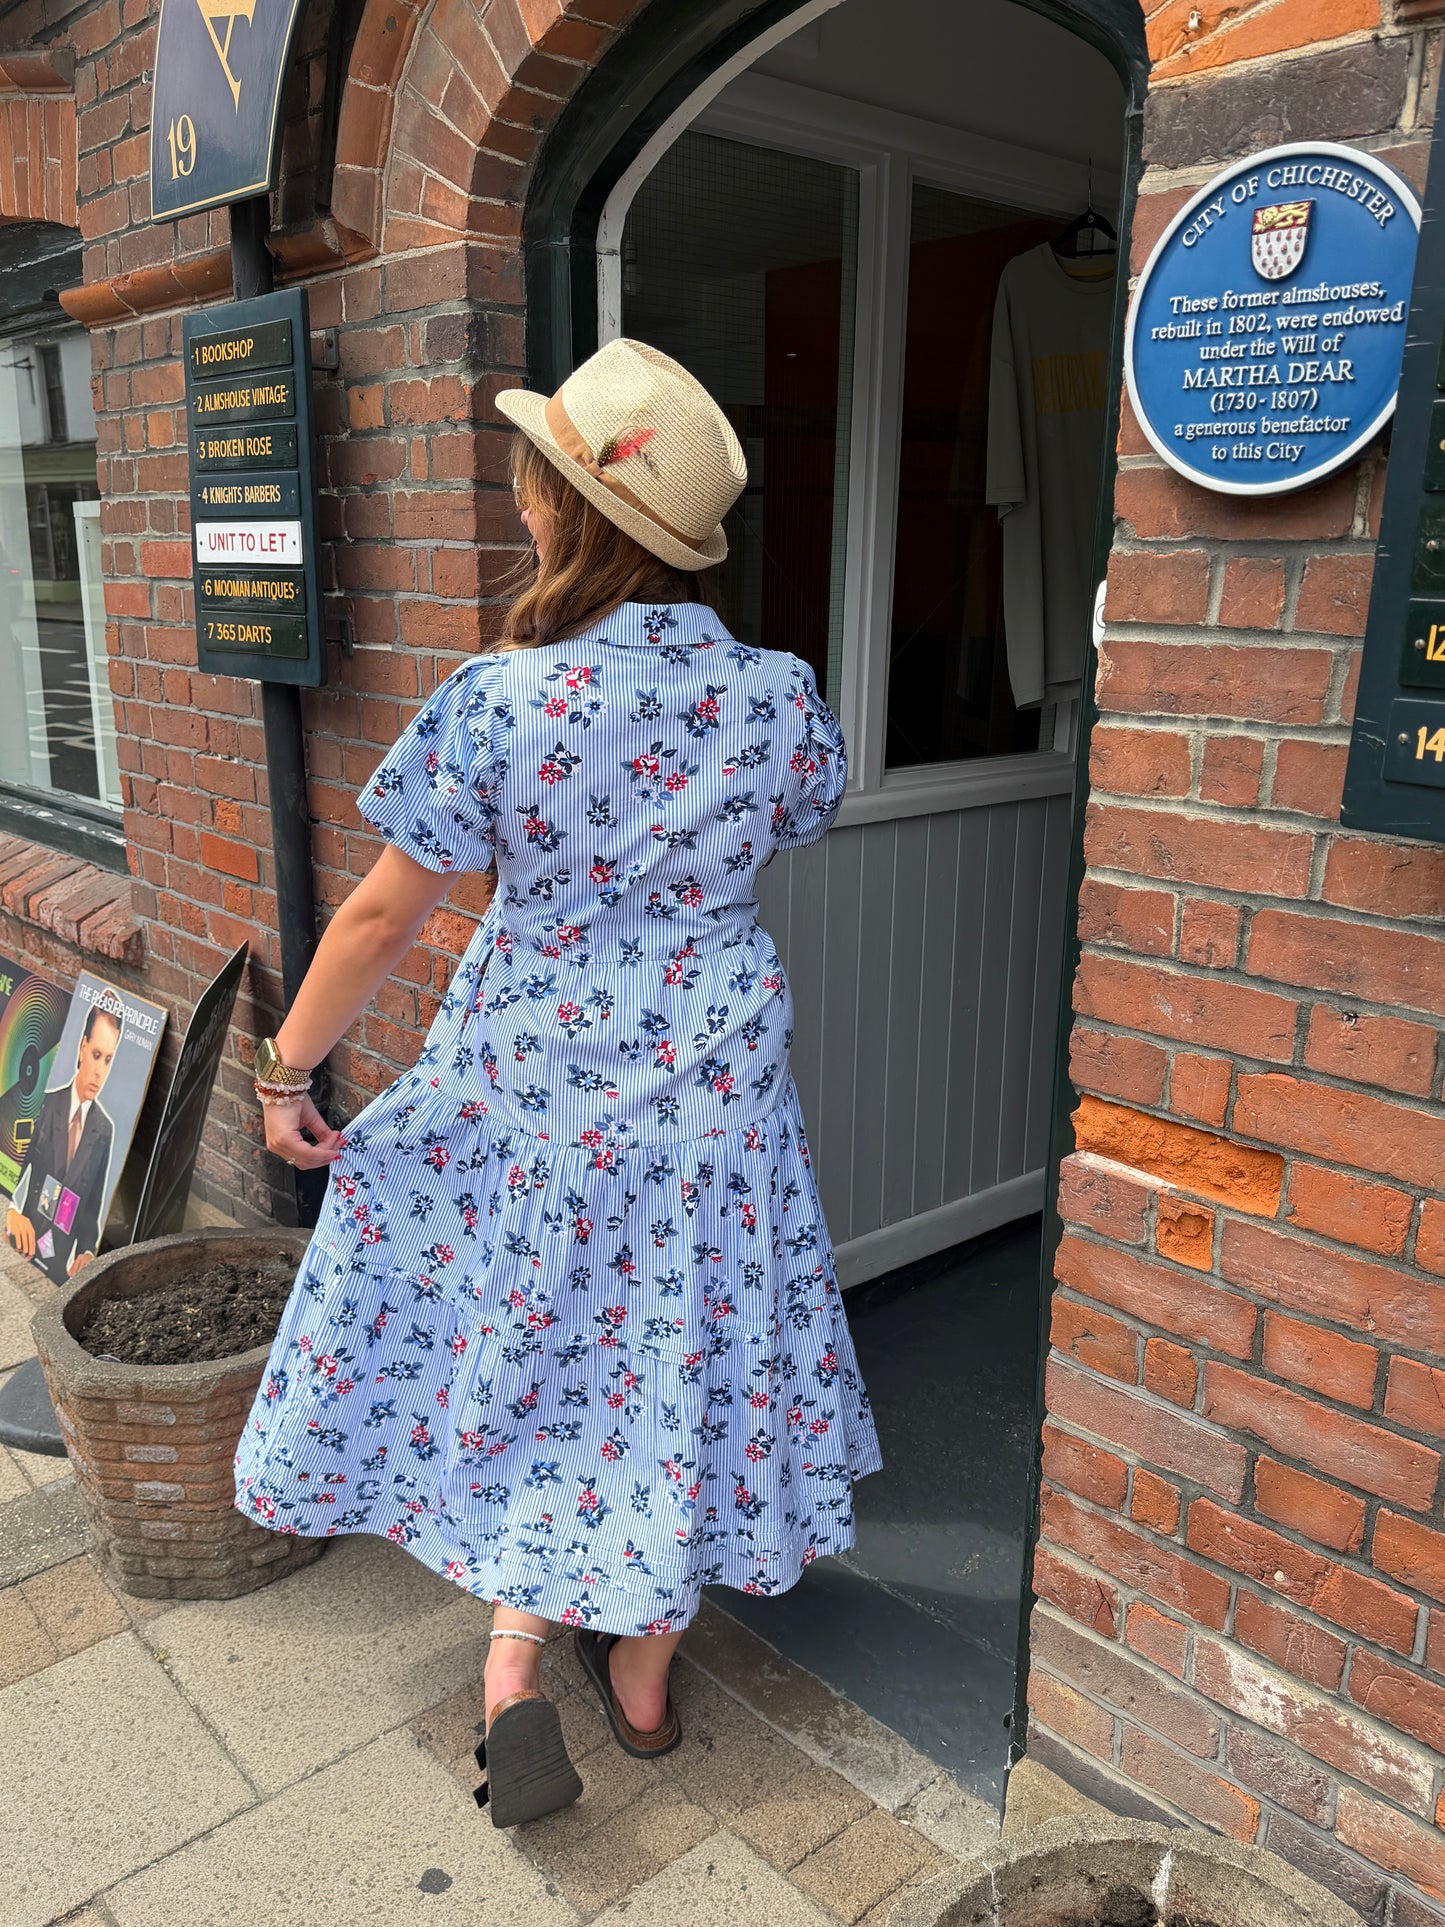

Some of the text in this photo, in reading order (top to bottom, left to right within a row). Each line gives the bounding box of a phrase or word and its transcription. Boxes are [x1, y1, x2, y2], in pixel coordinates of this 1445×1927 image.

[166, 114, 197, 180] 19
[1182, 165, 1395, 248] CITY OF CHICHESTER
[1169, 281, 1387, 315] These former almshouses,
[1151, 301, 1405, 340] rebuilt in 1802, were endowed
[194, 338, 254, 366] 1 BOOKSHOP
[1200, 331, 1345, 360] under the Will of
[1182, 359, 1355, 389] MARTHA DEAR
[197, 384, 287, 413] 2 ALMSHOUSE VINTAGE
[1174, 414, 1350, 441] a generous benefactor
[200, 436, 273, 460] 3 BROKEN ROSE
[1212, 442, 1304, 462] to this City
[202, 484, 281, 504] 4 KNIGHTS BARBERS
[208, 532, 287, 552] UNIT TO LET
[204, 579, 295, 600] 6 MOOMAN ANTIQUES
[207, 622, 272, 644] 7 365 DARTS
[1416, 726, 1445, 762] 14
[79, 984, 93, 1002] THE
